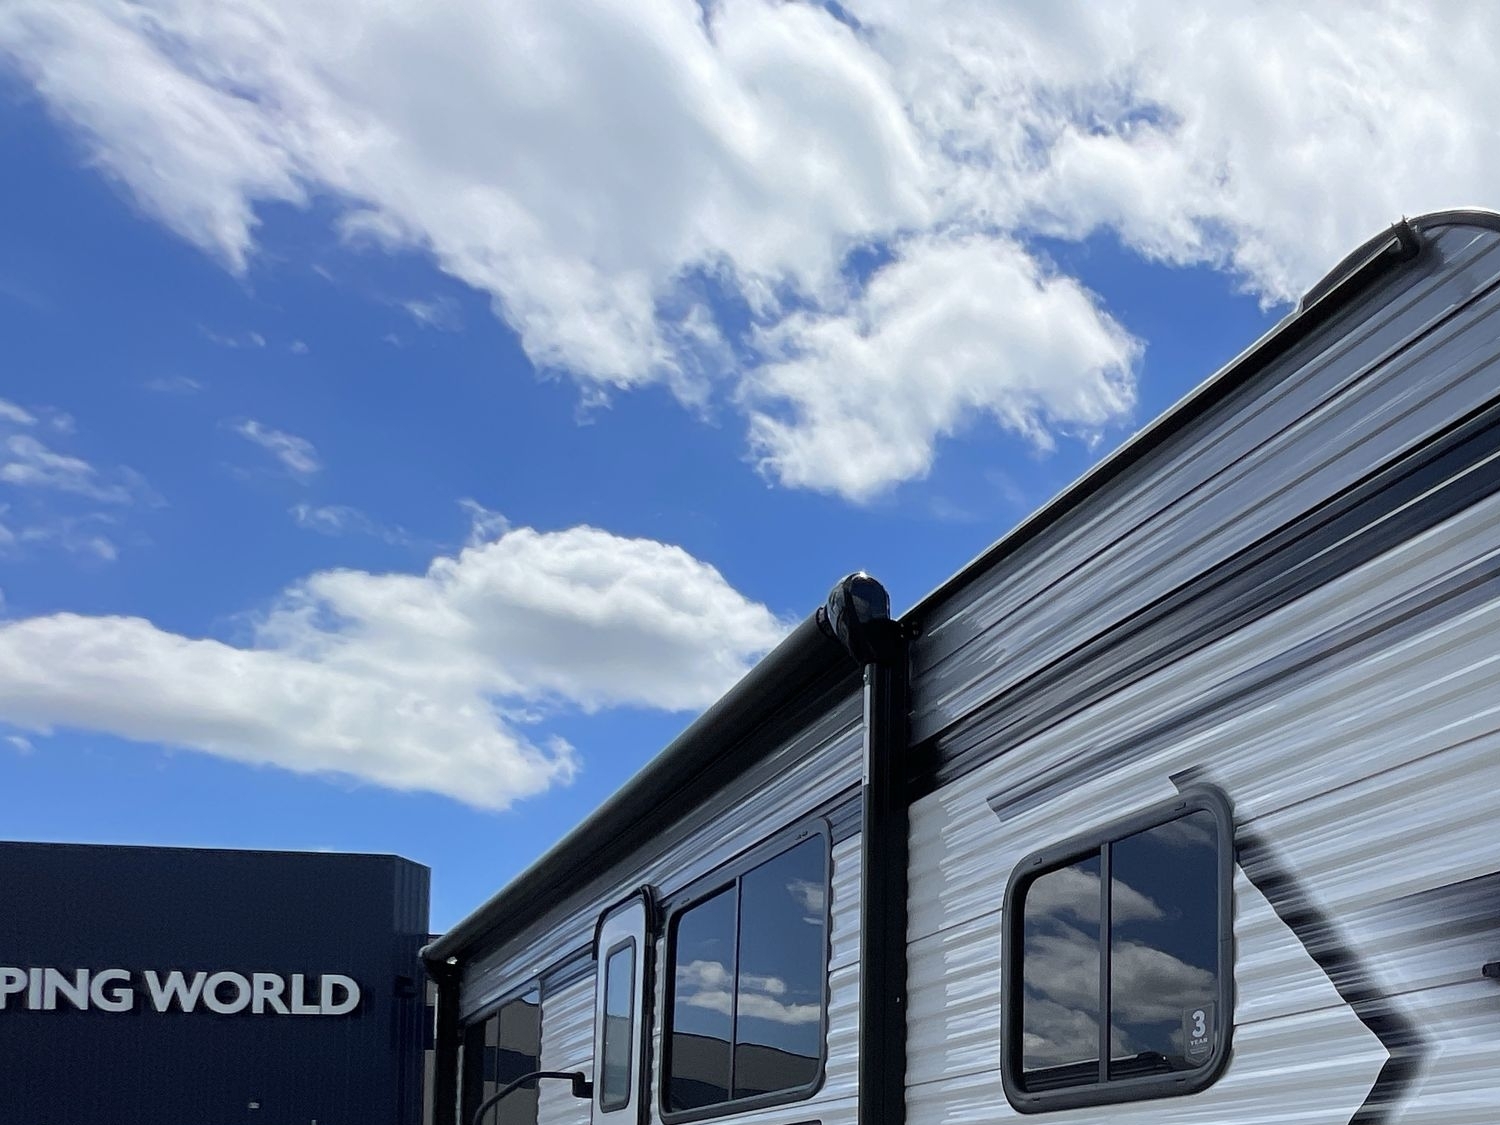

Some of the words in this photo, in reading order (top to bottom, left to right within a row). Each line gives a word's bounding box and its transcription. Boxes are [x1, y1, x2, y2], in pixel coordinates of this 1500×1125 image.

[0, 967, 133, 1012] PING
[144, 970, 361, 1014] WORLD
[1192, 1010, 1206, 1037] 3
[1190, 1038, 1208, 1046] YEAR
